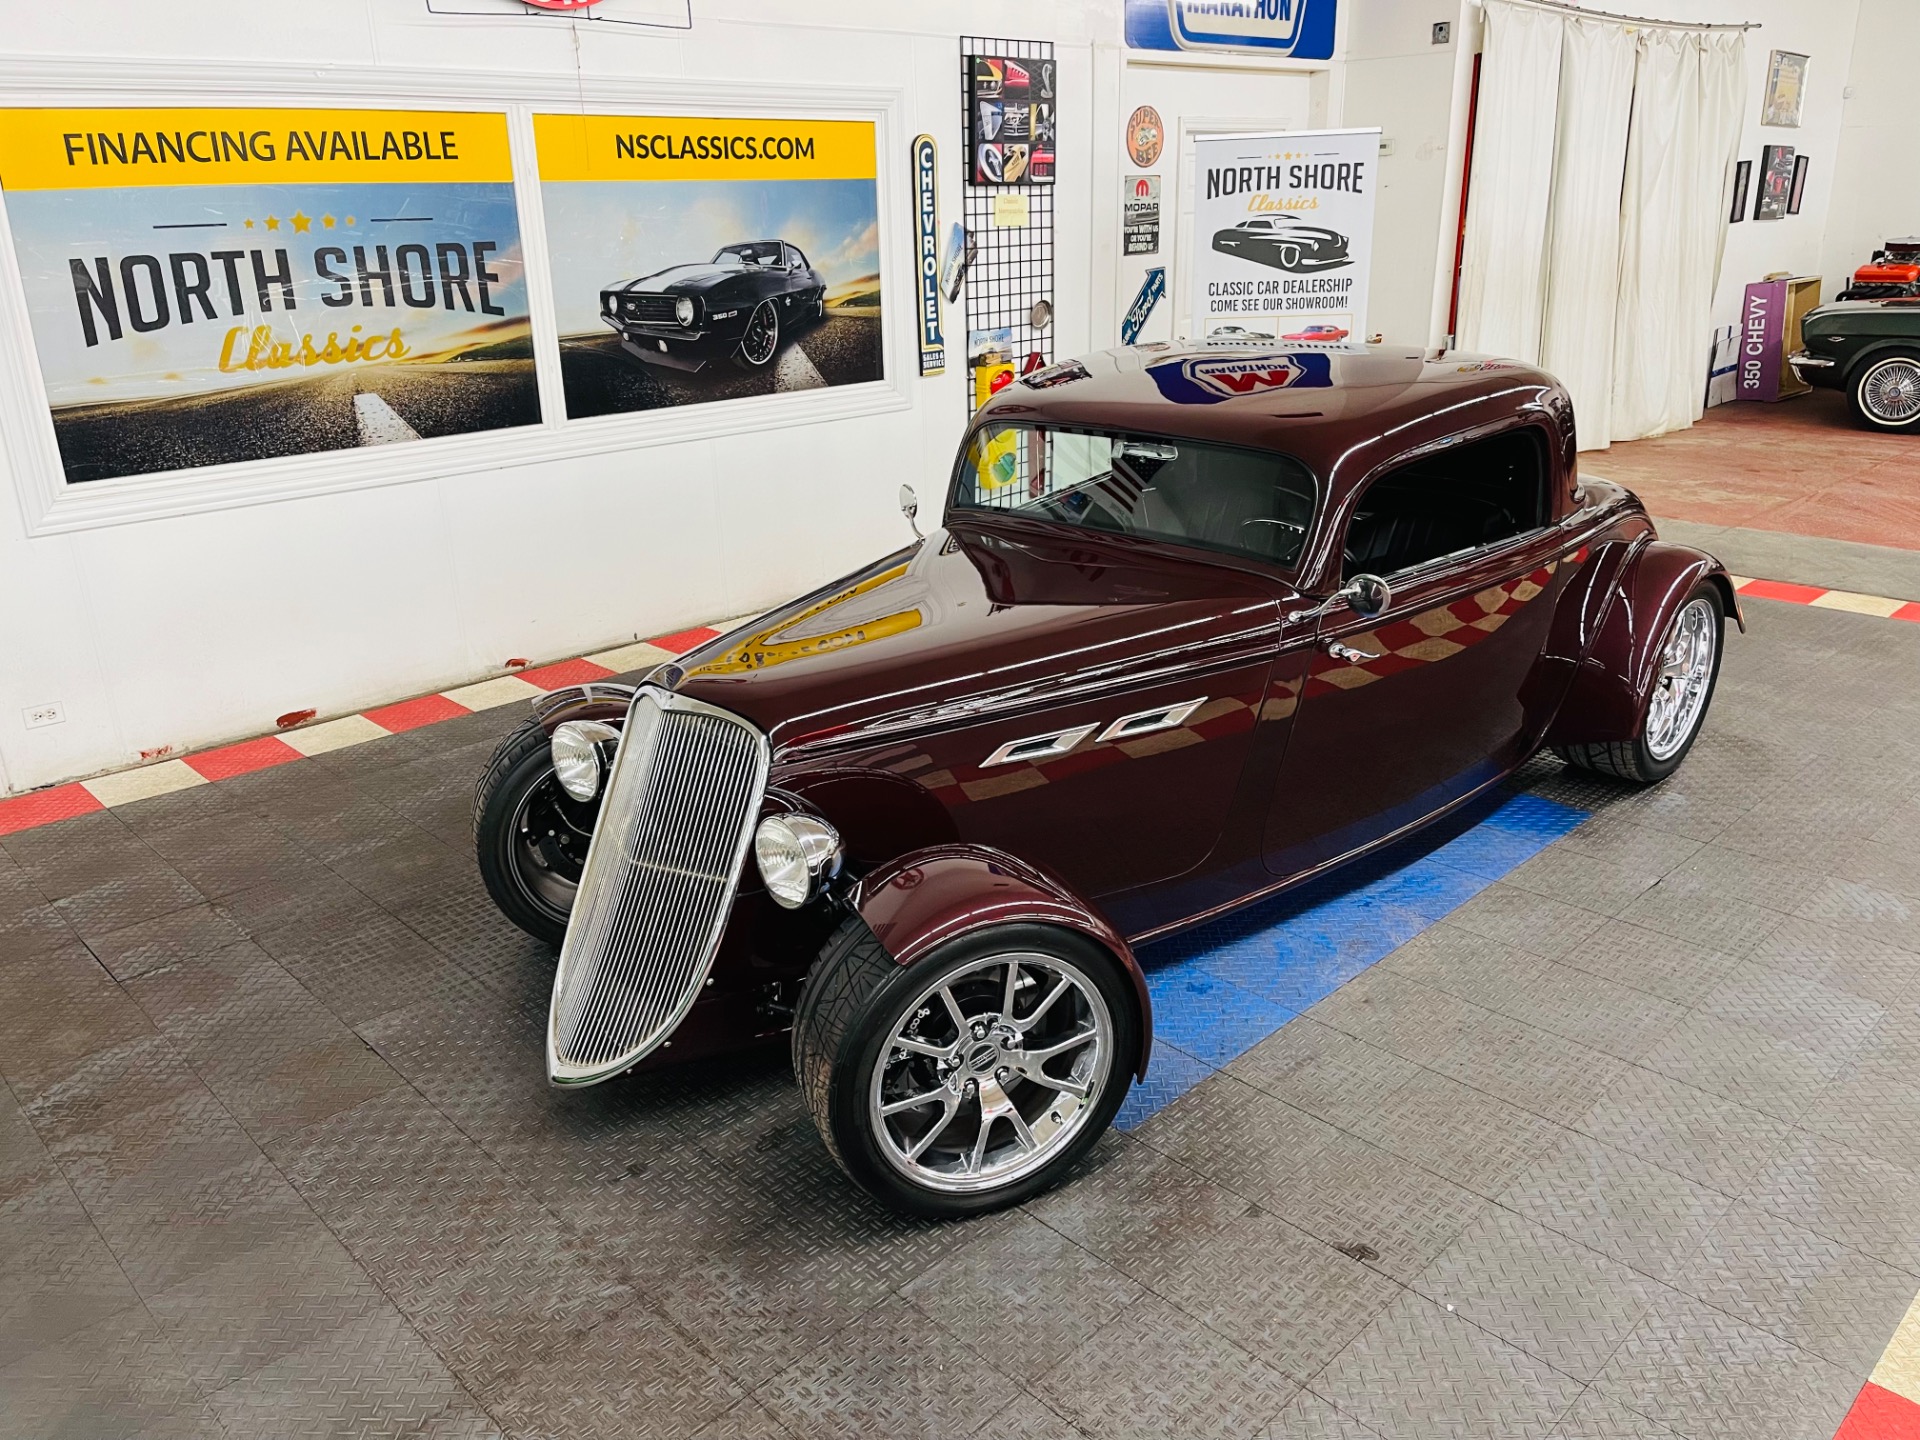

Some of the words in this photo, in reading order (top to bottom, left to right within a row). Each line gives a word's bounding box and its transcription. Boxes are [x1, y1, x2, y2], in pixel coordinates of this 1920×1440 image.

[1130, 109, 1160, 141] SUPER
[63, 130, 275, 166] FINANCING
[286, 131, 459, 162] AVAILABLE
[615, 134, 815, 160] NSCLASSICS.COM
[1135, 142, 1158, 164] BEE
[1206, 165, 1281, 200] NORTH
[1289, 162, 1364, 194] SHORE
[1124, 203, 1159, 212] MOPAR
[1247, 194, 1321, 212] Classics
[1139, 225, 1152, 233] WITH
[920, 148, 938, 341] CHEVROLET
[1128, 243, 1147, 252] BEHIND
[69, 248, 296, 347] NORTH
[314, 241, 505, 317] SHORE
[1208, 281, 1253, 297] CLASSIC
[1257, 280, 1279, 295] CAR
[1284, 278, 1353, 294] DEALERSHIP
[1131, 289, 1154, 332] Ford
[1150, 272, 1164, 292] PARTS
[1210, 299, 1238, 313] COME
[1242, 298, 1259, 311] SEE
[1263, 297, 1283, 310] OUR
[1285, 295, 1348, 310] SHOWROOM!
[1746, 295, 1768, 356] CHEVY
[218, 323, 411, 374] Classics
[923, 352, 939, 361] SALES
[923, 359, 944, 368] SERVICE
[1743, 360, 1762, 389] 350
